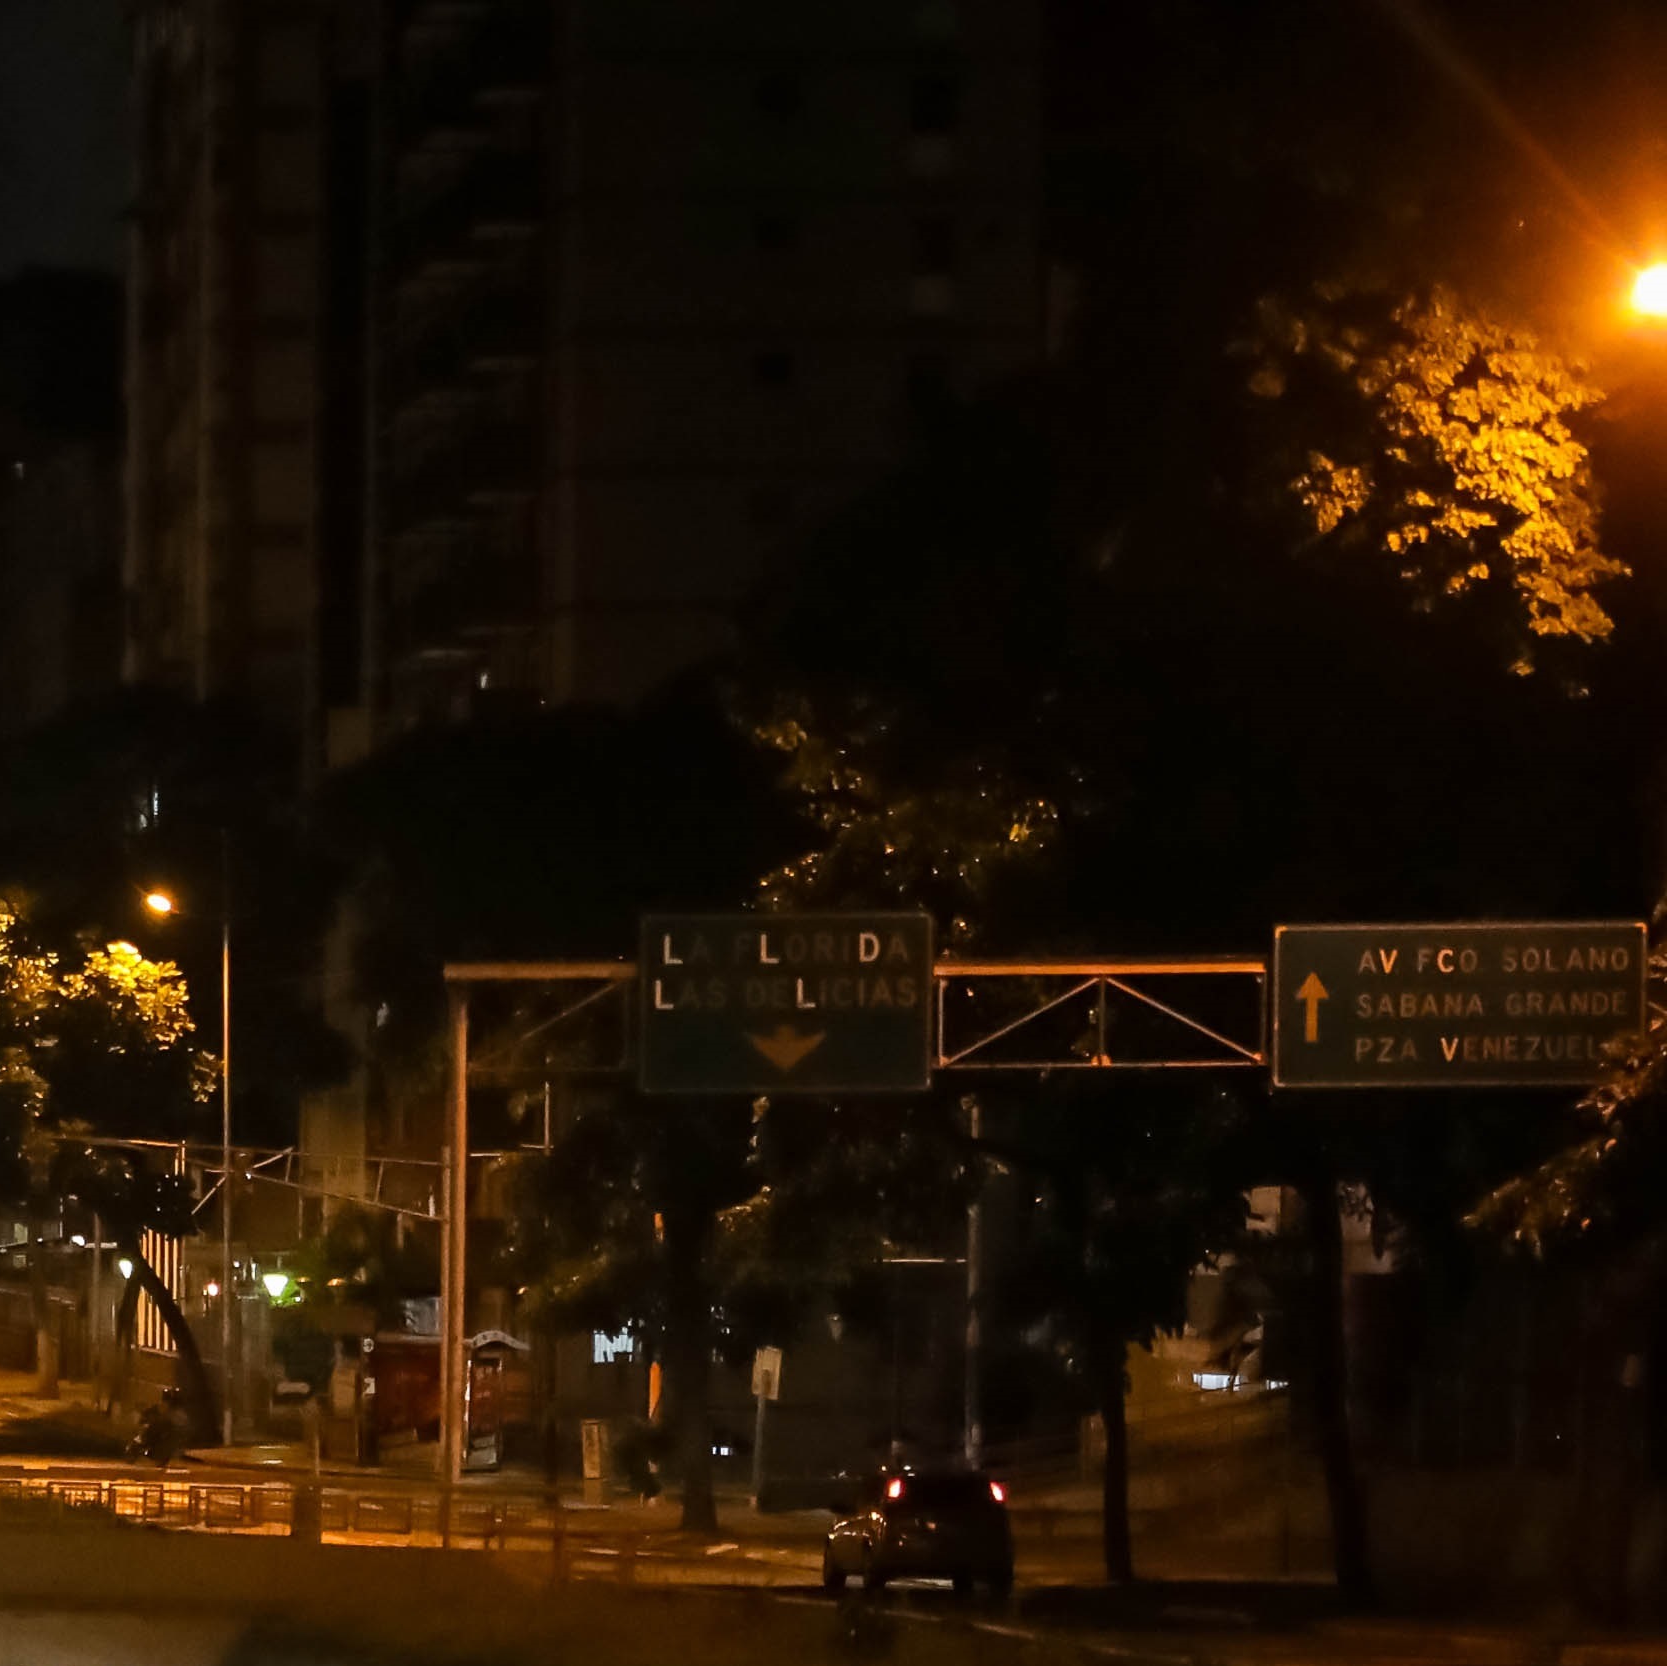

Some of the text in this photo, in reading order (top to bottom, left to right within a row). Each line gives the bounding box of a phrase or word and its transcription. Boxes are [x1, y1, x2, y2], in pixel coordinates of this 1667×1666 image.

[663, 931, 909, 965] LA FLORIDA
[1501, 946, 1630, 973] SOLANO
[654, 976, 916, 1010] LAS DELICIAS
[1355, 990, 1628, 1019] SABANA GRANDE
[1355, 1034, 1607, 1063] PZA VENEZUEL
